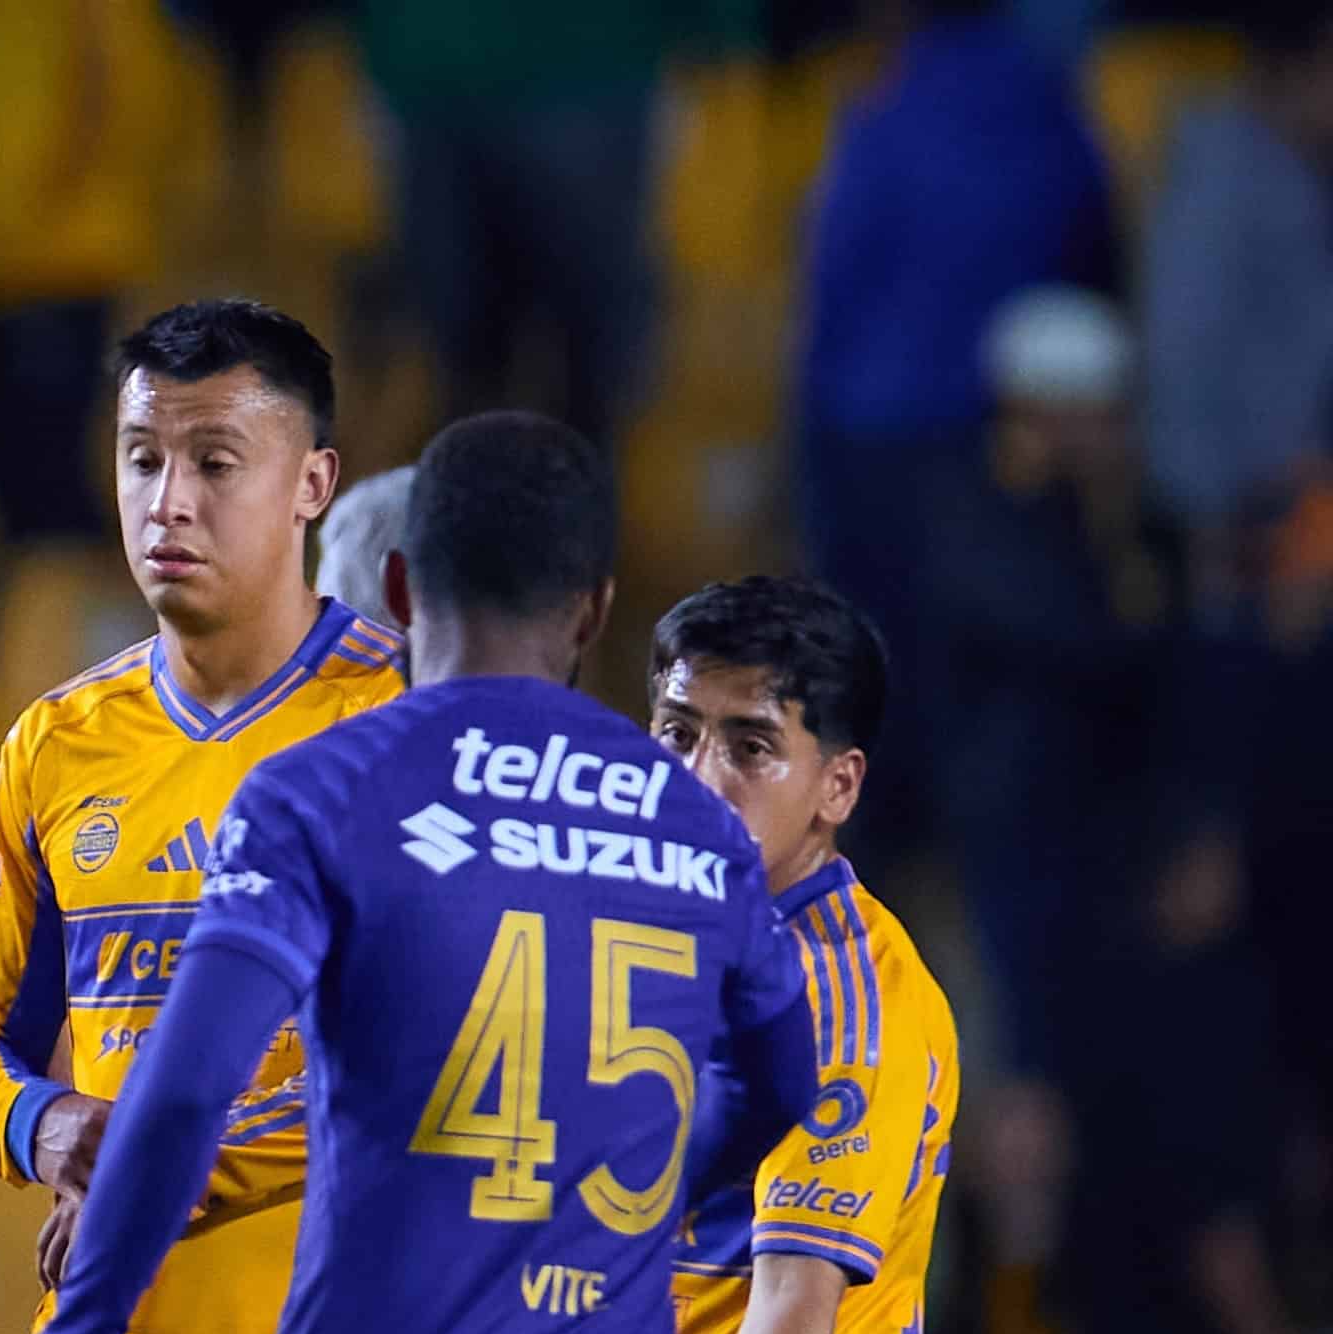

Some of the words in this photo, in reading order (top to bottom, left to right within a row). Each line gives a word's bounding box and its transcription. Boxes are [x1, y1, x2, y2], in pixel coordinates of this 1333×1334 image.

[452, 727, 671, 820] telcel
[489, 817, 728, 902] SUZUKI
[408, 908, 697, 1236] 45
[808, 1130, 870, 1164] Berel
[762, 1175, 873, 1219] telcel
[520, 1263, 610, 1316] VITE
